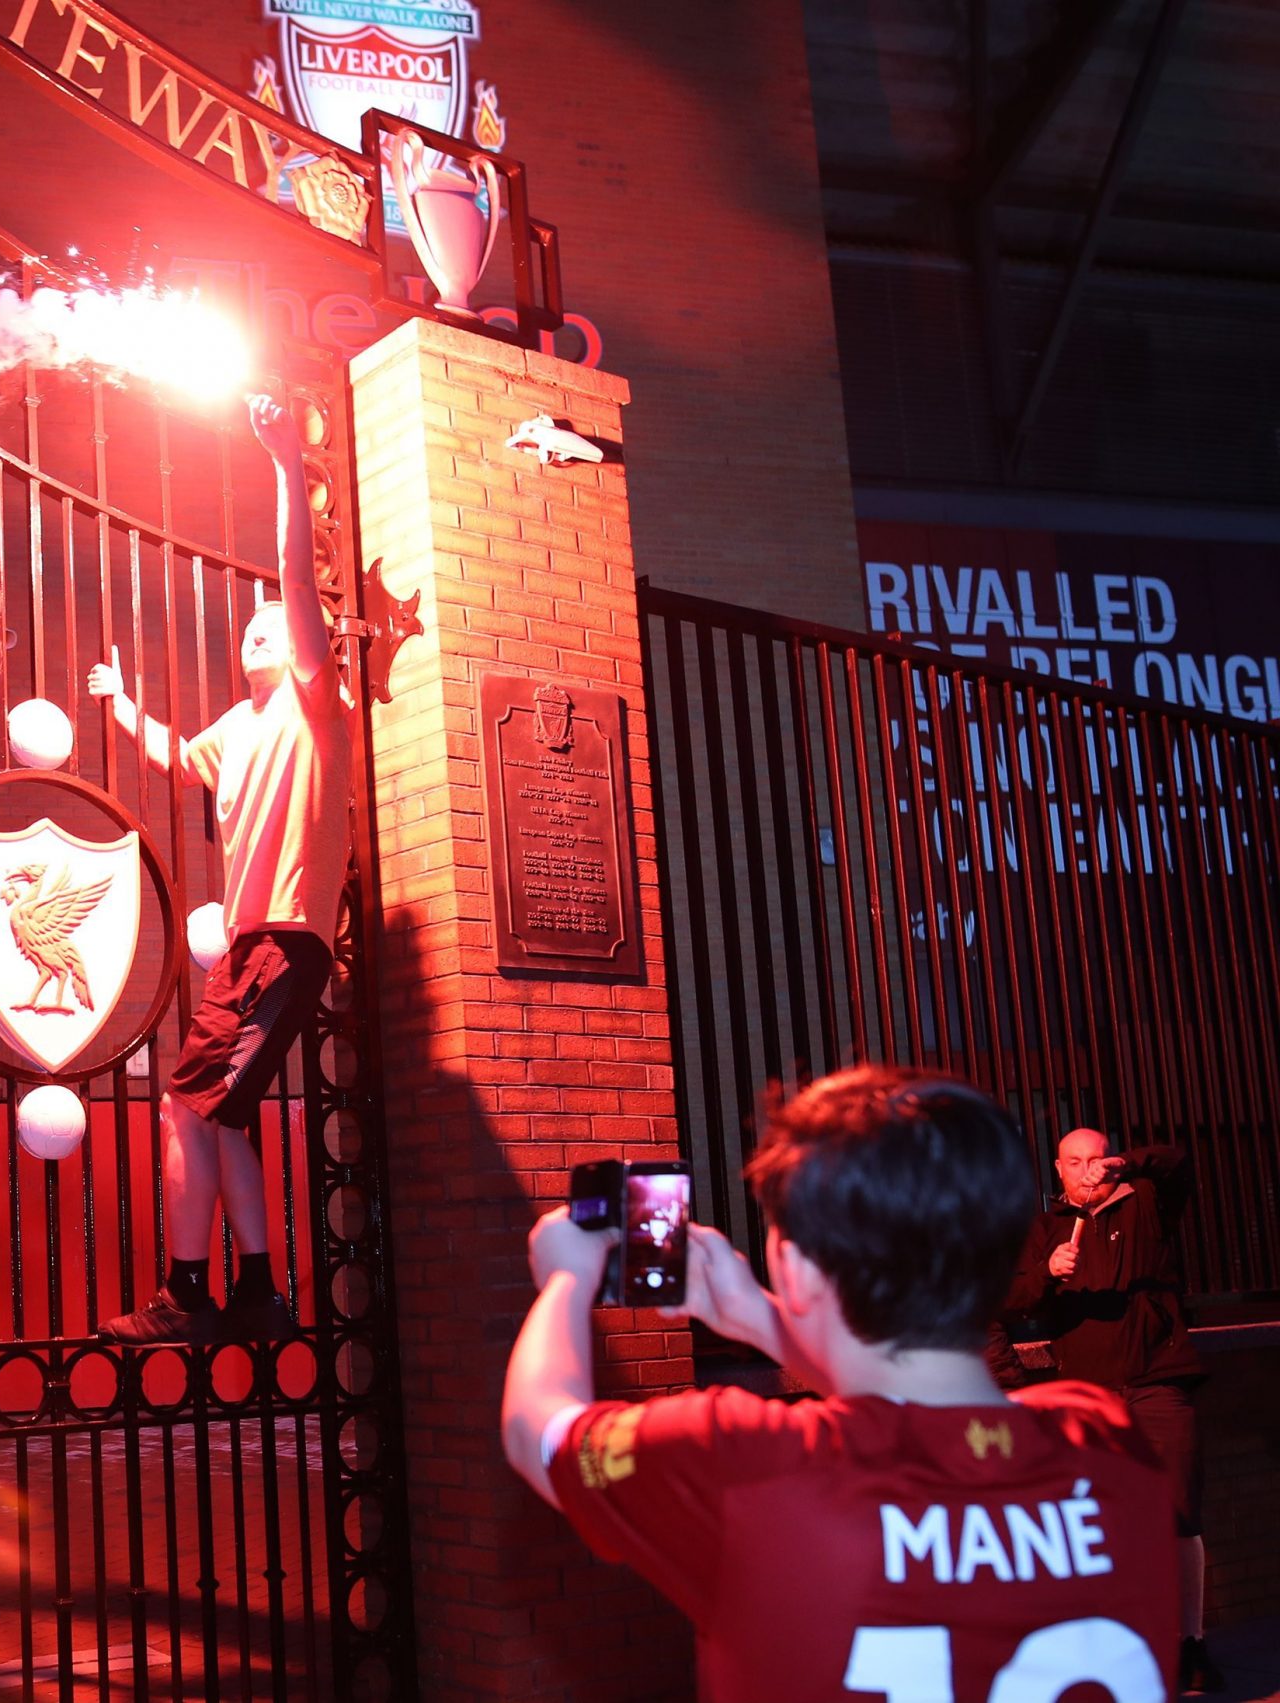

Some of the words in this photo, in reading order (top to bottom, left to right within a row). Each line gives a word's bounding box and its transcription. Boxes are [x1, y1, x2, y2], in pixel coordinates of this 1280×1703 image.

[419, 13, 472, 31] ALONE
[300, 42, 451, 83] LIVERPOOL
[308, 75, 396, 95] FOOTBALL
[407, 86, 445, 100] CLUB
[386, 205, 402, 221] 18
[866, 562, 1178, 644] RIVALLED
[879, 1477, 1113, 1584] MANÉ
